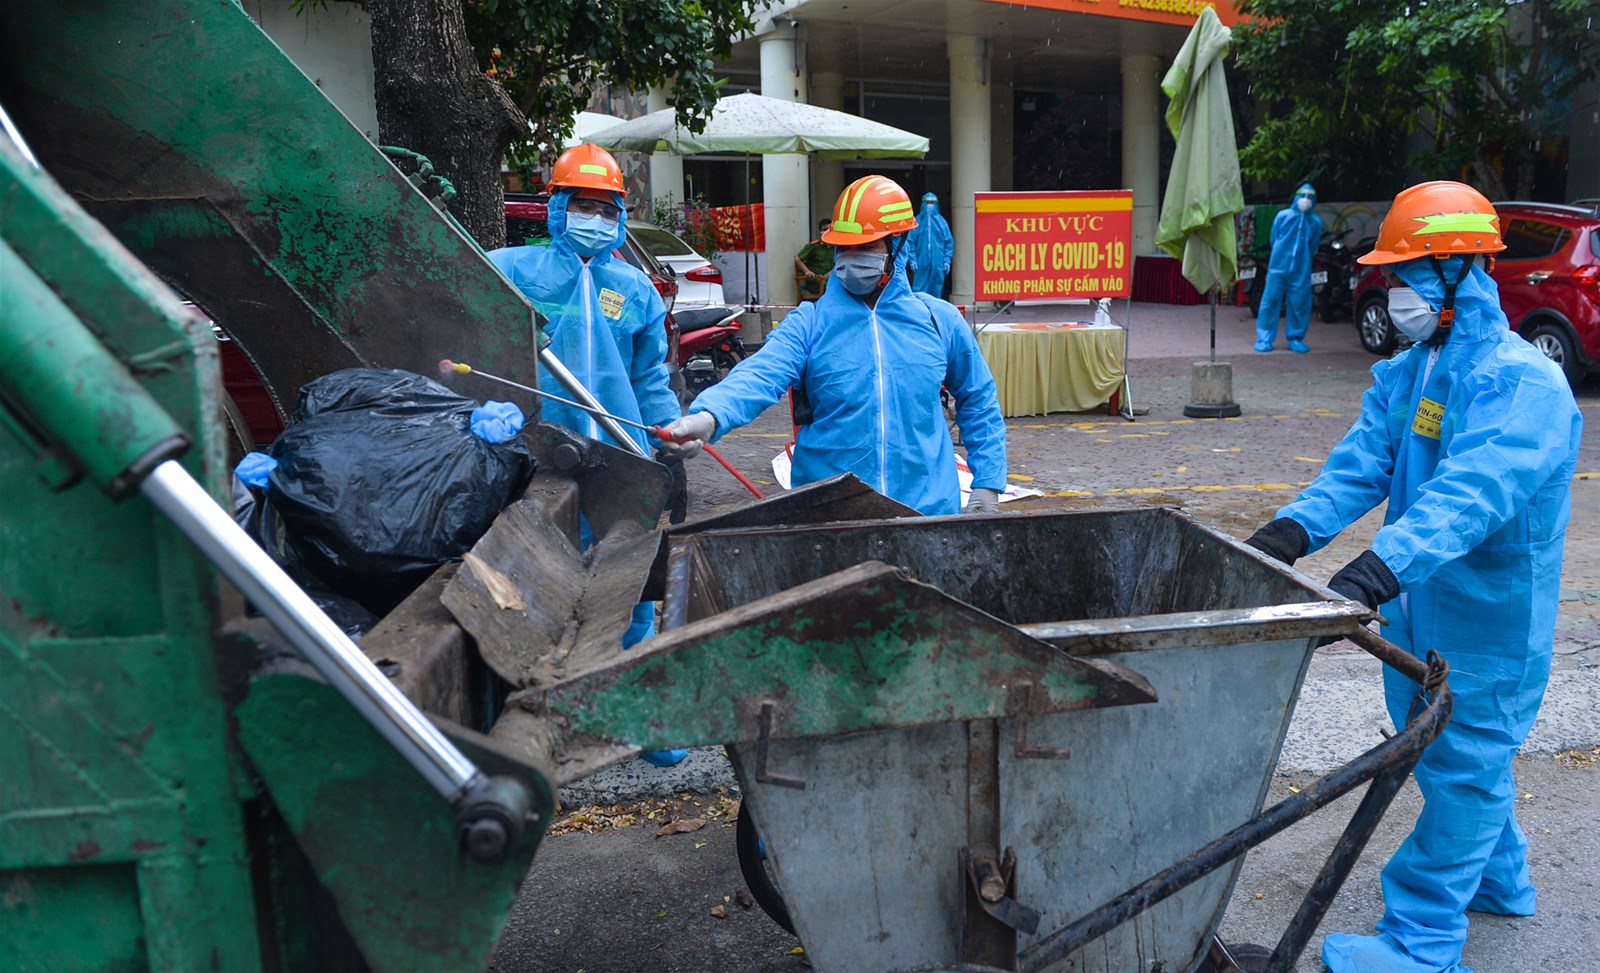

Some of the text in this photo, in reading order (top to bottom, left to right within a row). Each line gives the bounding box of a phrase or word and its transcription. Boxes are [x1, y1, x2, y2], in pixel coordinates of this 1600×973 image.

[1005, 214, 1104, 235] KHU VỰC
[983, 238, 1125, 272] CÁCH LY COVID-19
[983, 273, 1123, 296] KHÔNG PHẬN SỰ CẤM VÀO
